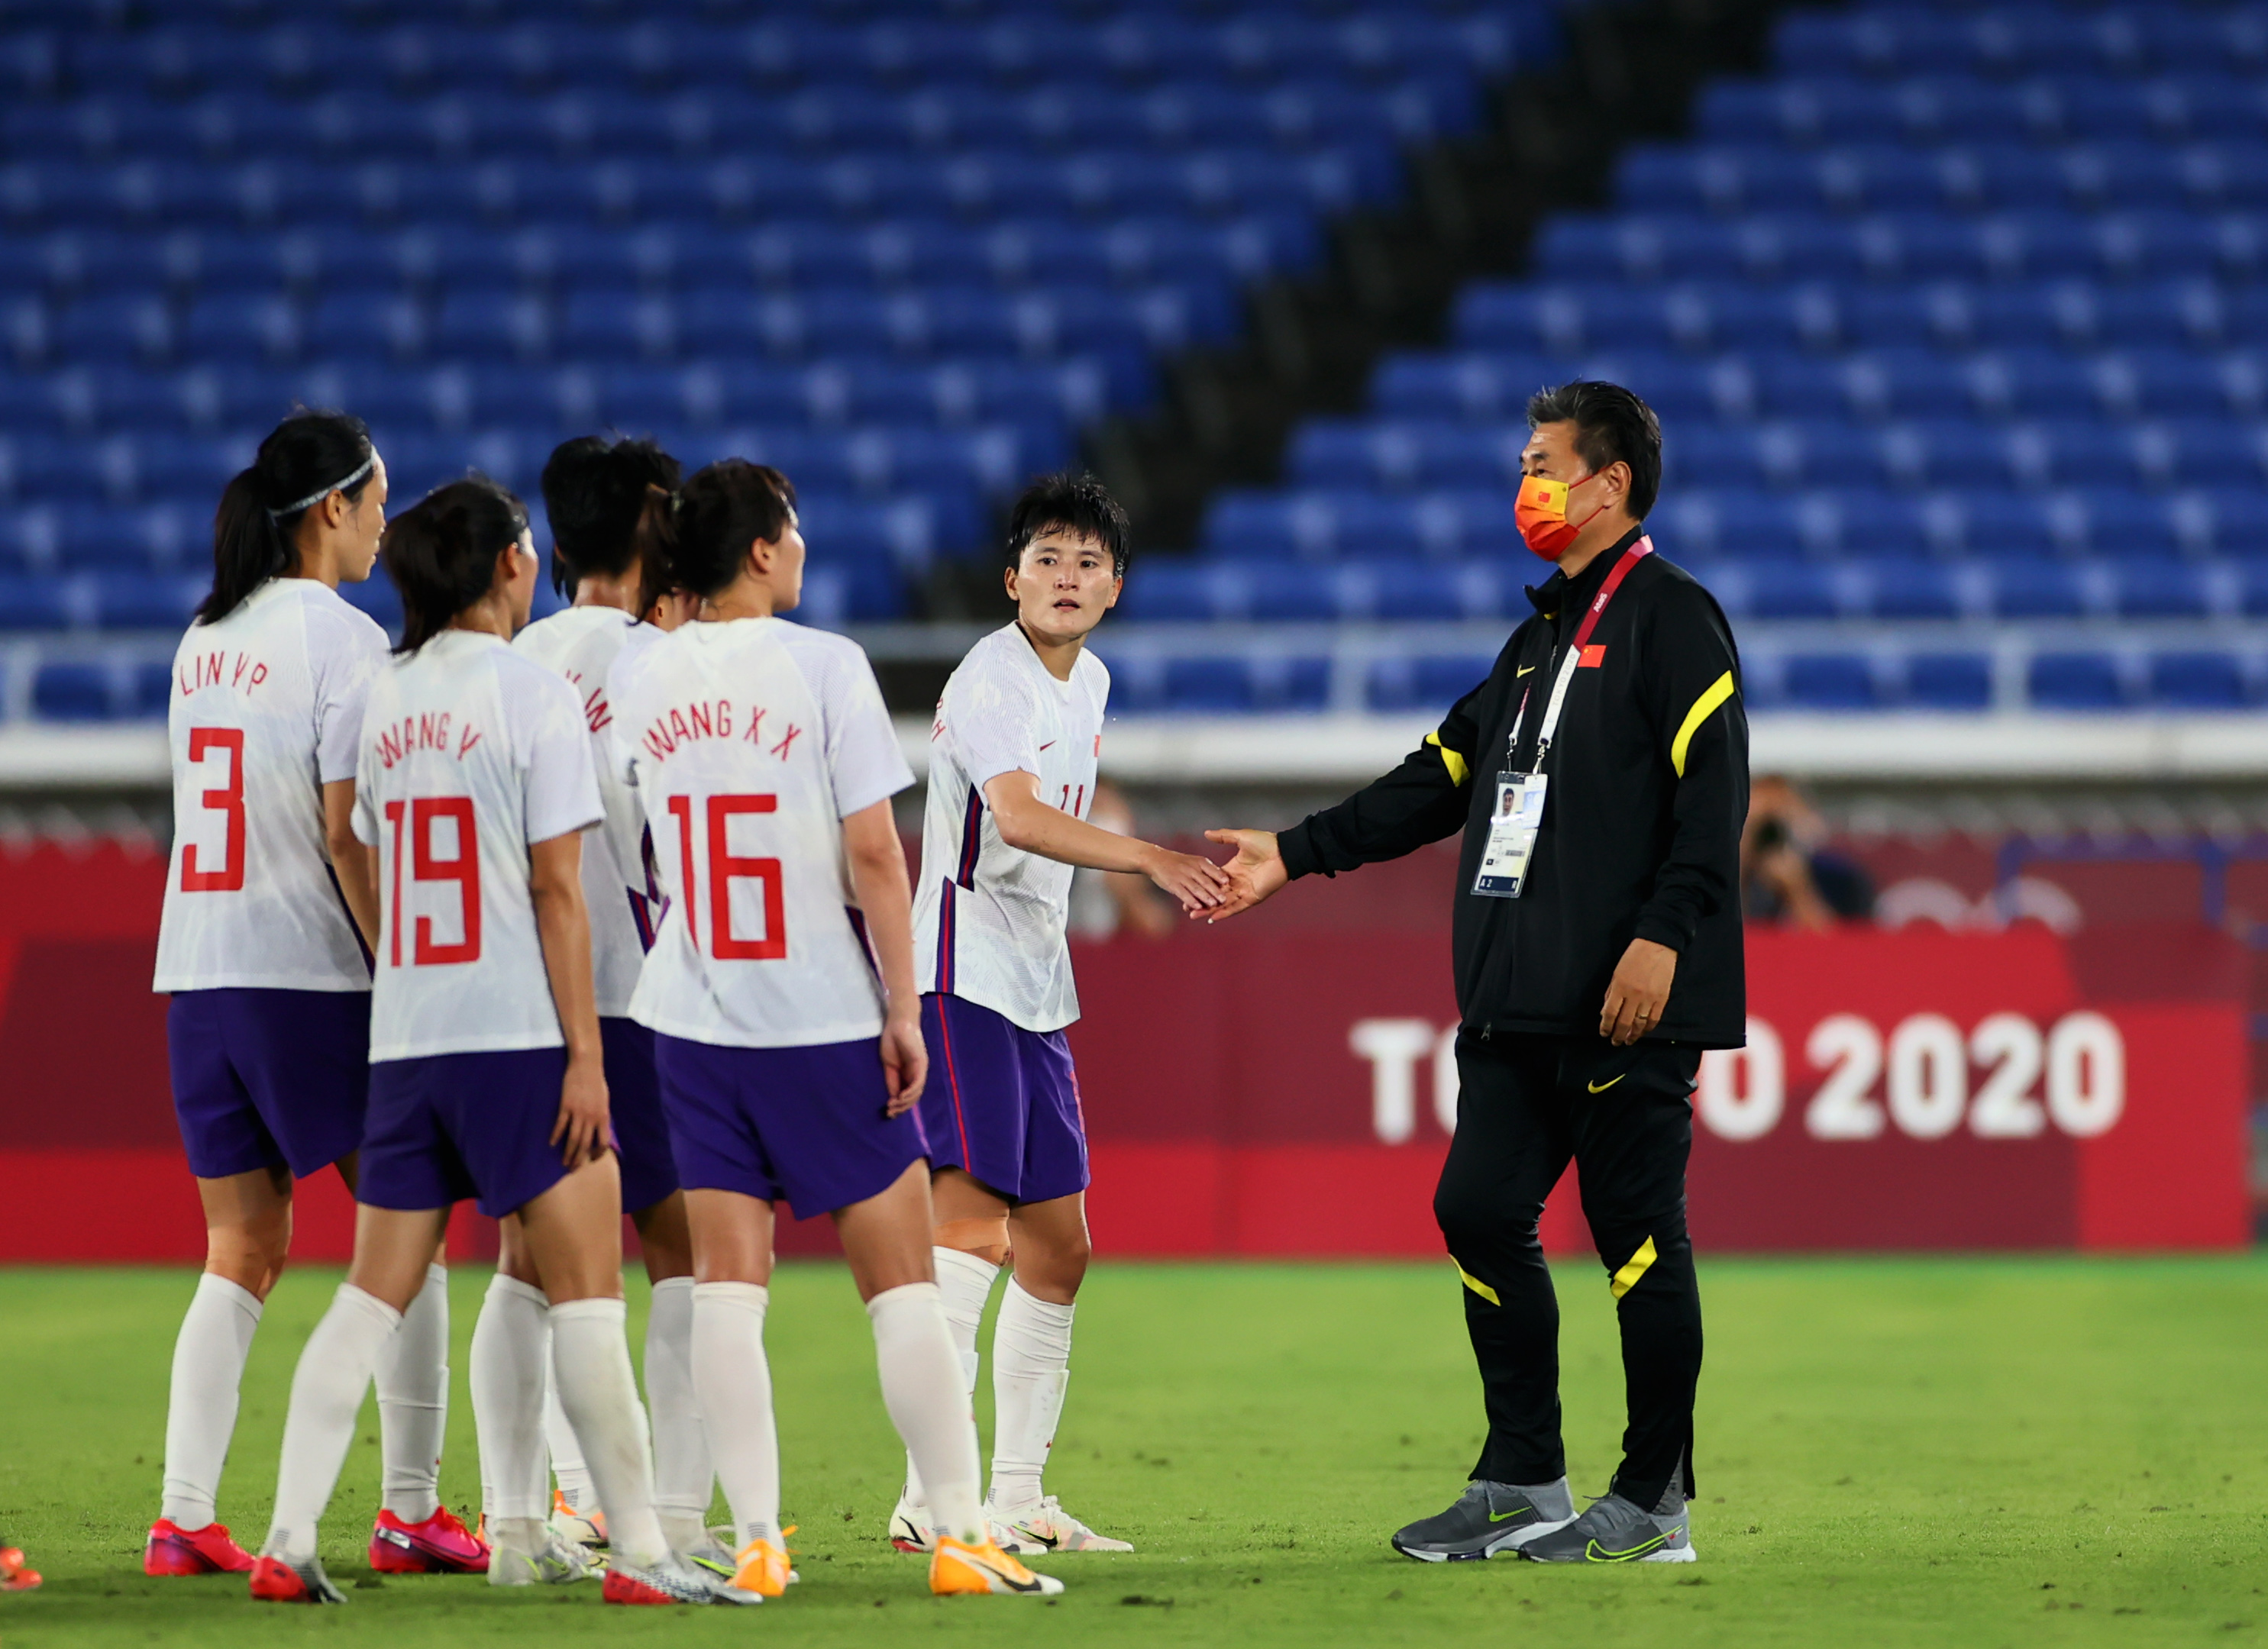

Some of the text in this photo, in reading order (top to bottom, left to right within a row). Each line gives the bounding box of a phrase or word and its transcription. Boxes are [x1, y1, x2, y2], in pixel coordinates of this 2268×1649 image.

[179, 650, 225, 696] LIN
[641, 699, 802, 763] WANG X X
[374, 712, 481, 770] WANG Y
[180, 727, 245, 892] 3
[384, 796, 482, 967] 19
[667, 794, 787, 960] 16
[1804, 1009, 2127, 1140] 2020
